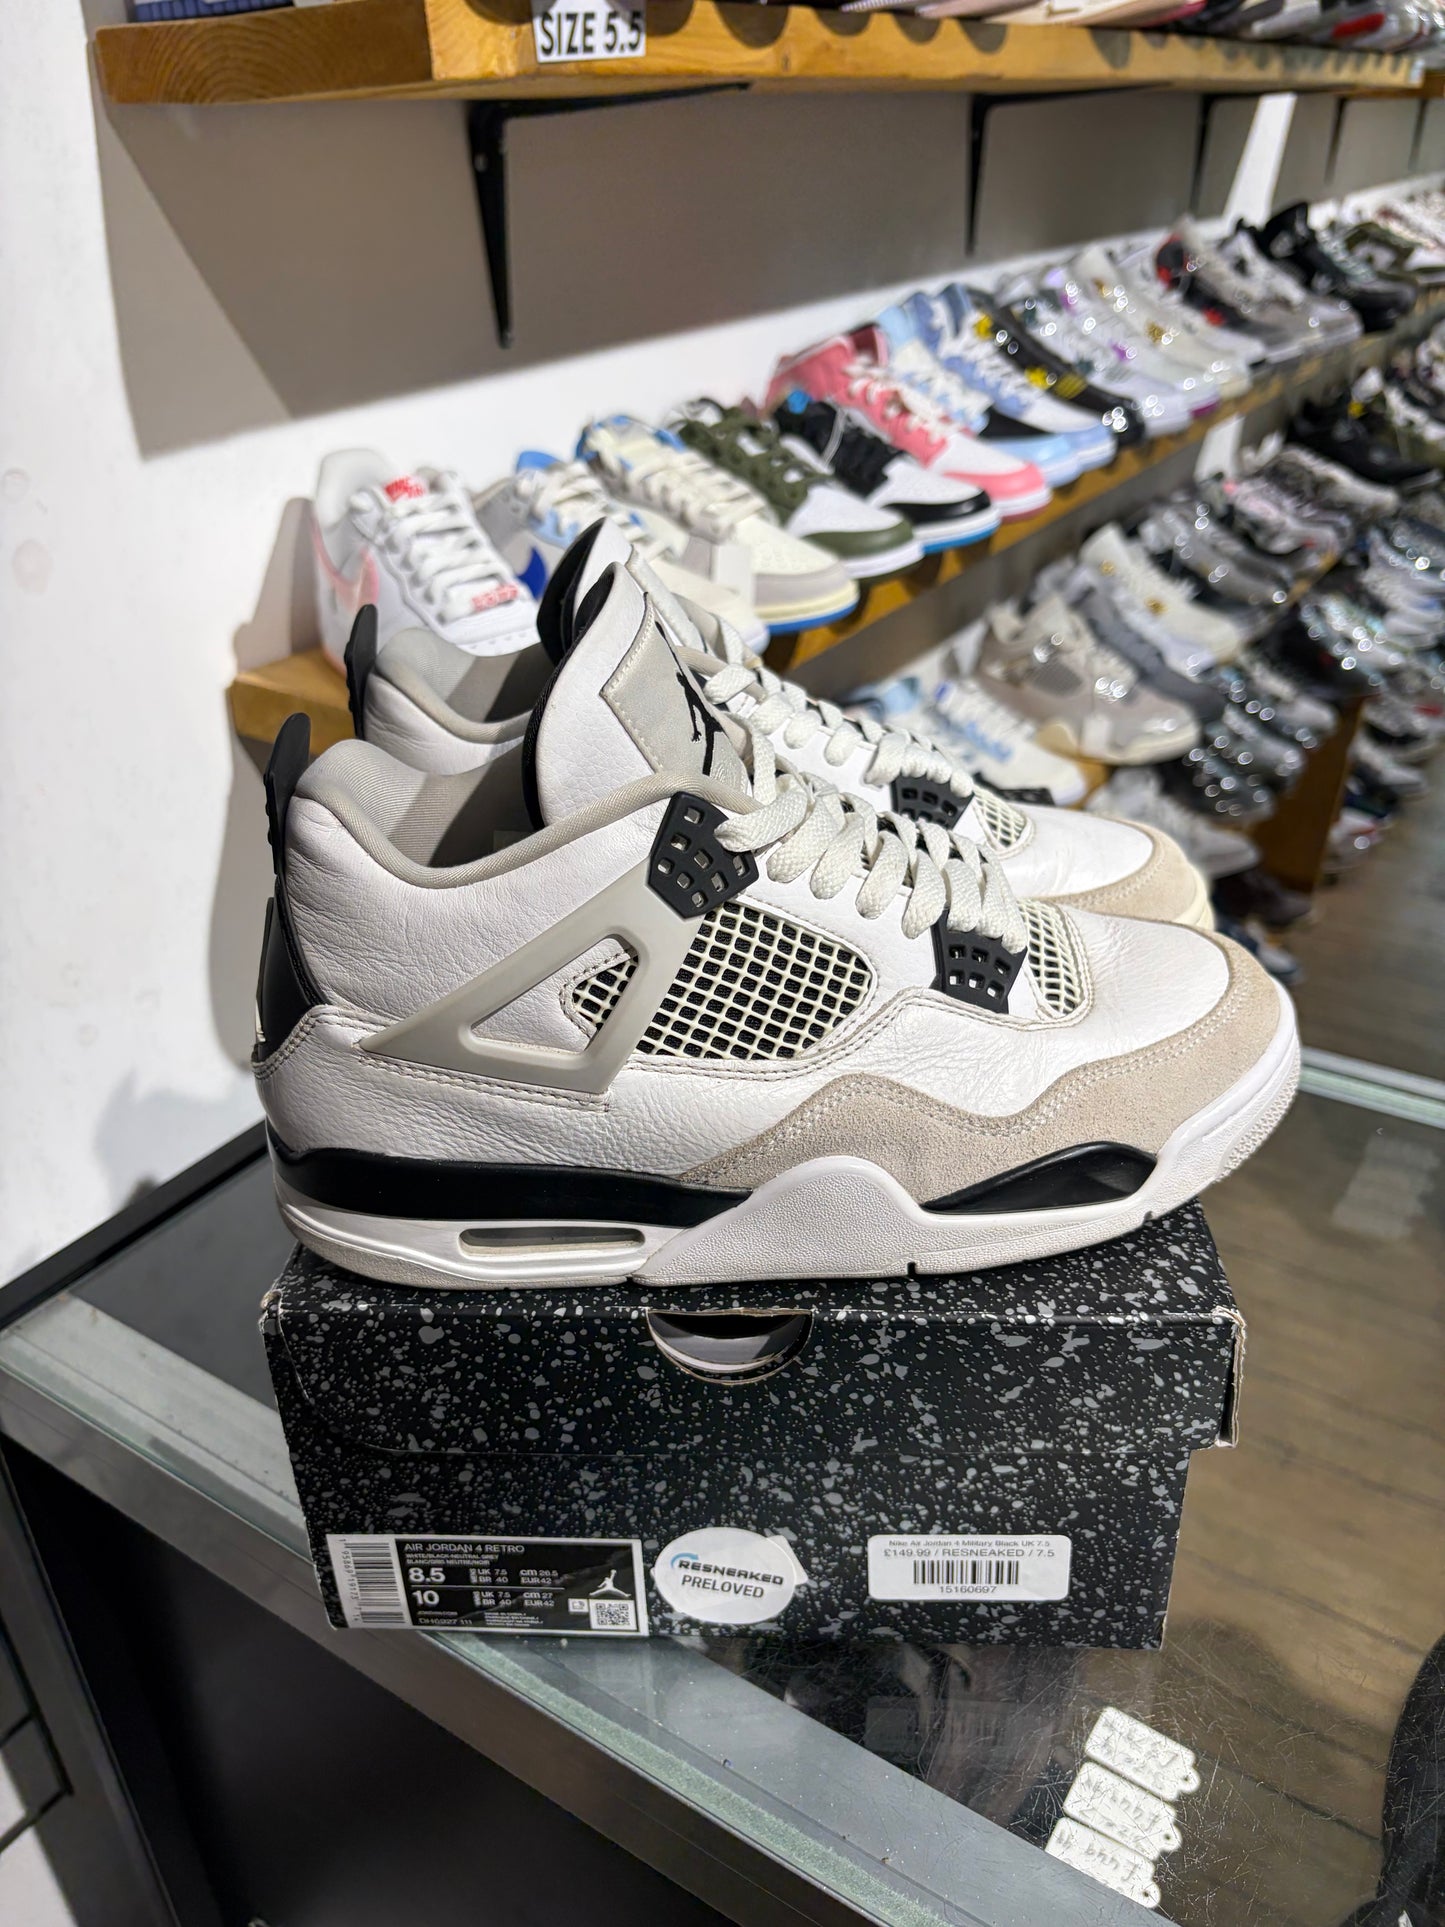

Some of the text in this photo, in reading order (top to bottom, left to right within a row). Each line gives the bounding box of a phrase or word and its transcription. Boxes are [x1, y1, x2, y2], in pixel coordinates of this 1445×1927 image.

[540, 10, 642, 55] SIZE 5.5
[404, 1543, 525, 1553] AIR JORDAN 4 RETRO
[884, 1549, 1055, 1557] £149.99 / RESNEAKED / 7.5
[408, 1567, 446, 1583] 8.5
[678, 1559, 784, 1586] RESNEAKED
[681, 1575, 764, 1599] PRELOVED
[939, 1586, 996, 1594] 15160697
[412, 1590, 440, 1606] 10
